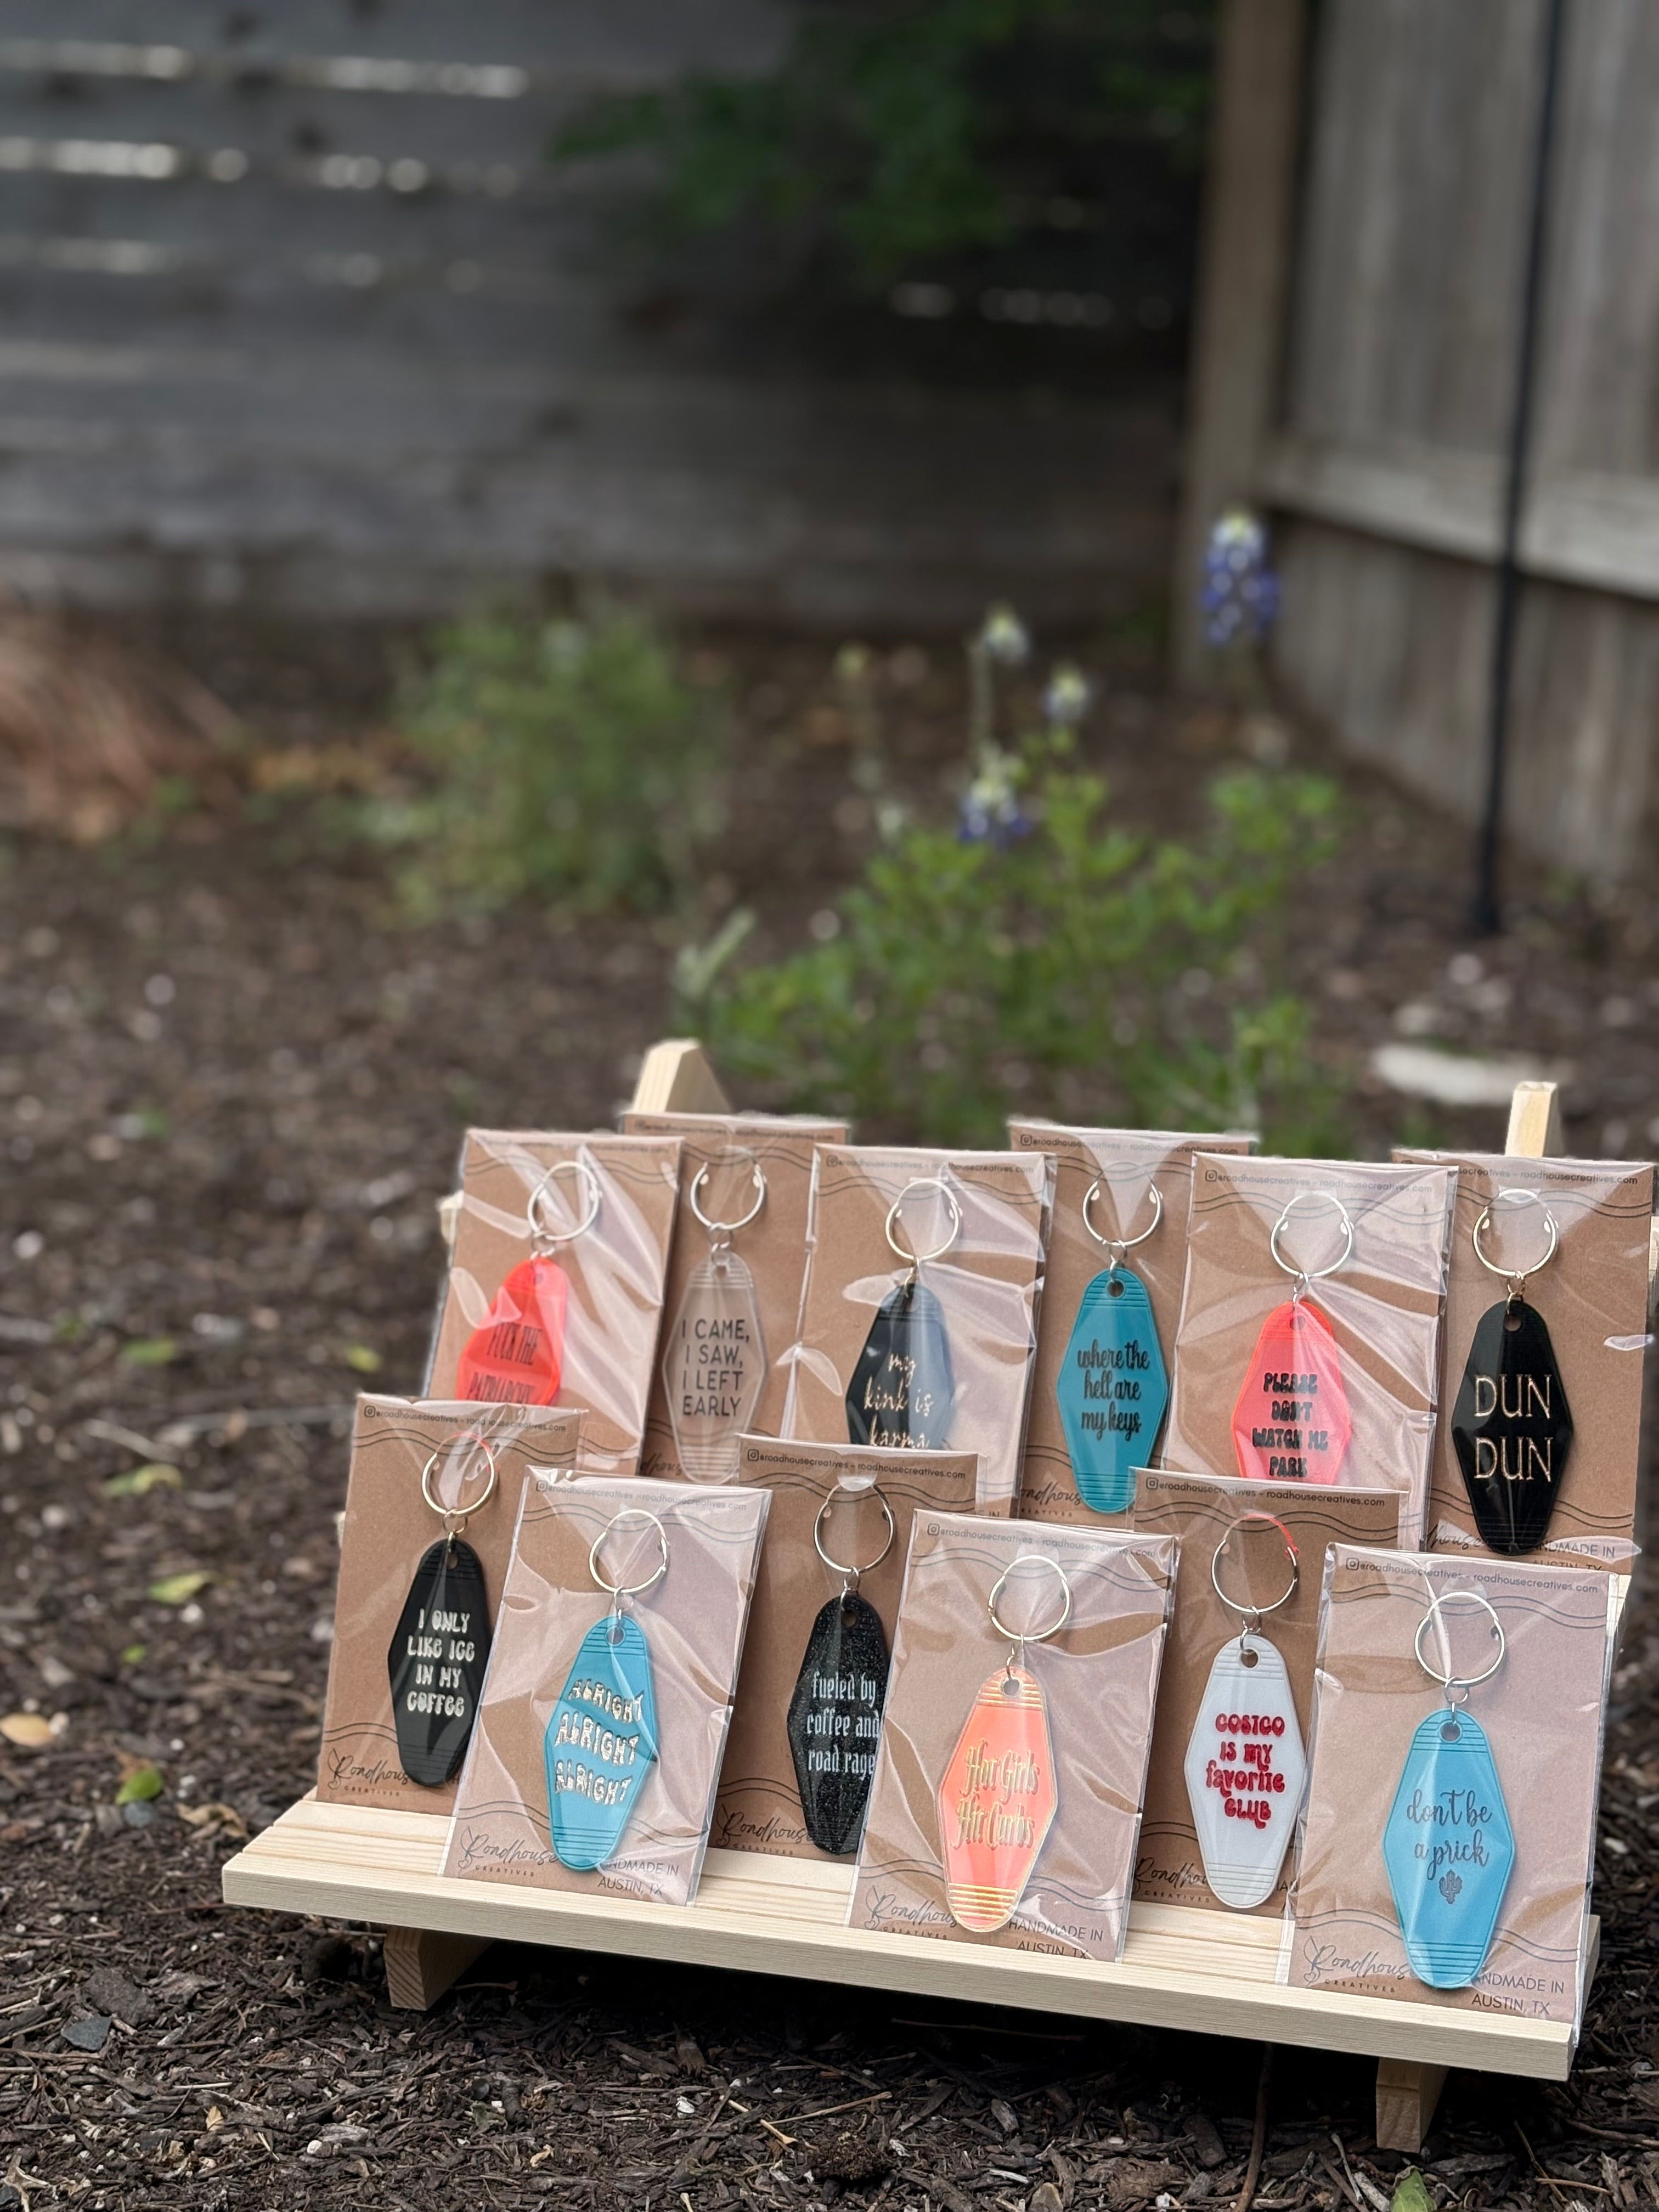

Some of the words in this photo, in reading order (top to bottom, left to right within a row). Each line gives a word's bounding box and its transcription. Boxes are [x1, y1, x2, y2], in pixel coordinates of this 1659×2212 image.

[1520, 1170, 1638, 1185] roadhousecreatives.com
[681, 1318, 686, 1338] I
[695, 1318, 750, 1343] CAME,
[686, 1345, 690, 1364] I
[698, 1344, 743, 1369] SAW,
[1077, 1339, 1125, 1369] where
[1124, 1339, 1150, 1370] the
[682, 1369, 687, 1390] I
[696, 1369, 743, 1391] LEFT
[888, 1353, 917, 1387] my
[1263, 1372, 1318, 1394] PLEASE
[864, 1374, 909, 1412] kink
[915, 1388, 934, 1417] is
[1084, 1369, 1113, 1400] hell
[1114, 1379, 1142, 1400] are
[1474, 1373, 1552, 1420] DUN
[682, 1395, 742, 1417] EARLY
[870, 1413, 930, 1448] karma
[1081, 1410, 1107, 1441] my
[1108, 1400, 1142, 1442] keys
[1251, 1427, 1303, 1449] WATCH
[1307, 1429, 1328, 1451] ME
[857, 1463, 967, 1480] roadhousecreatives.com
[1269, 1455, 1308, 1478] PARK
[1474, 1435, 1553, 1482] DUN
[642, 1493, 747, 1511] roadhousecreatives.com
[1266, 1489, 1386, 1507] roadhousecreatives.com
[1602, 1545, 1615, 1558] IN
[1473, 1573, 1598, 1594] roadhousecreatives.com
[418, 1608, 425, 1629] I
[431, 1609, 471, 1633] ONLY
[407, 1635, 443, 1658] LIKE
[448, 1639, 476, 1662] ICE
[415, 1663, 435, 1685] IN
[438, 1666, 462, 1689] MY
[812, 1670, 856, 1701] fueled
[860, 1672, 877, 1708] by
[407, 1690, 465, 1717] COFFEE
[567, 1678, 645, 1724] ALRIGHT
[806, 1707, 851, 1736] coffee
[855, 1708, 881, 1738] and
[1215, 1713, 1285, 1737] COSTCO
[554, 1711, 640, 1767] ALRIGHT
[808, 1743, 840, 1773] road
[844, 1751, 876, 1782] rage
[554, 1758, 633, 1806] ALRIGHT
[998, 1749, 1040, 1805] Girls
[1224, 1797, 1272, 1829] CLUB
[1407, 1788, 1465, 1826] don't
[1466, 1790, 1493, 1828] be
[986, 1801, 1035, 1850] Curbs
[1414, 1842, 1429, 1860] a
[1426, 1829, 1489, 1880] prick
[667, 1865, 679, 1876] IN
[597, 1877, 644, 1894] AUSTIN,
[649, 1882, 664, 1896] TX
[1009, 1918, 1087, 1939] HANDMADE
[1090, 1928, 1104, 1942] IN
[1073, 1947, 1089, 1960] TX
[1550, 1980, 1565, 1994] IN
[1471, 1993, 1527, 2014] AUSTIN,
[1532, 2000, 1550, 2016] TX
